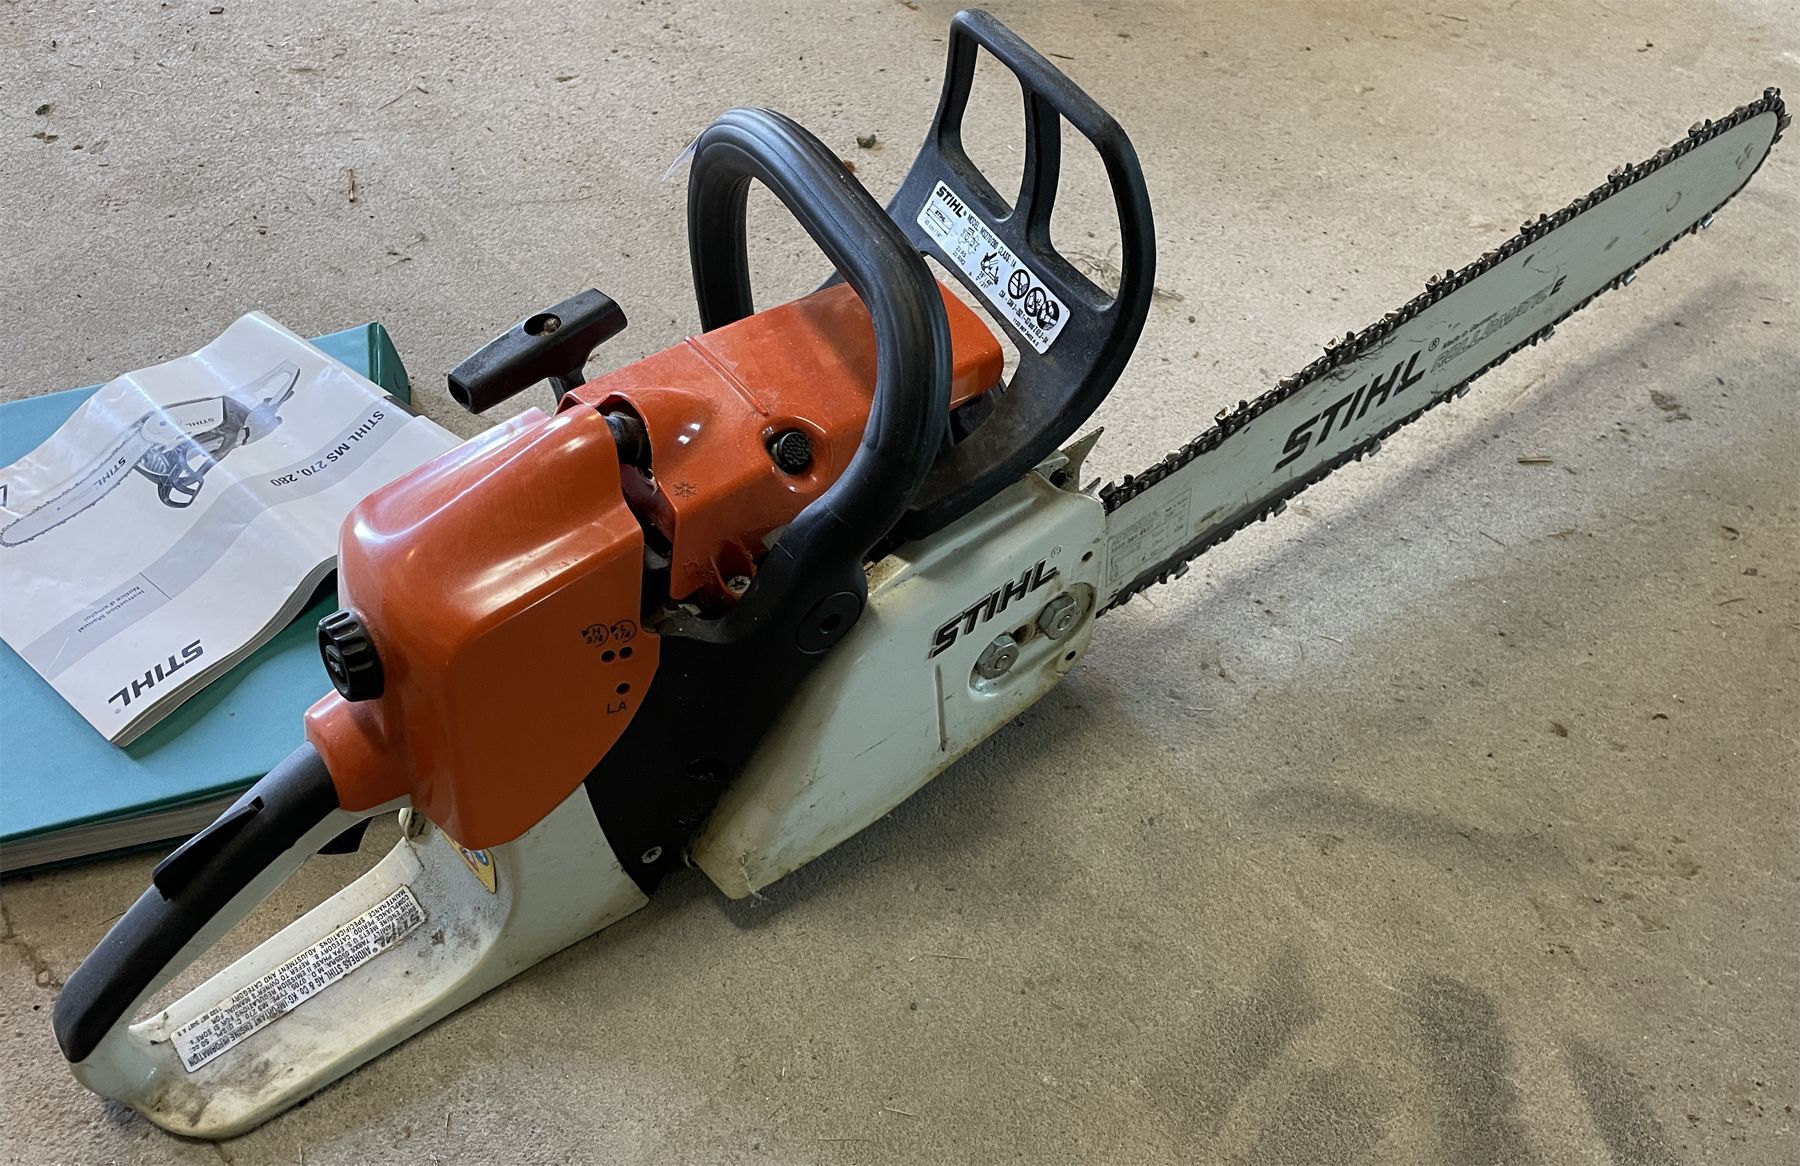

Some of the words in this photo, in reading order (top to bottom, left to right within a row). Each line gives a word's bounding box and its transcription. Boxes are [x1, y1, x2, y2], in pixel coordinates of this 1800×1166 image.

[935, 183, 966, 218] STIHL
[1549, 275, 1567, 297] E
[1272, 351, 1426, 473] STIHL
[348, 411, 384, 441] STIHL
[326, 443, 350, 463] MS
[93, 457, 126, 487] STIHL
[270, 474, 297, 487] 280
[105, 590, 145, 616] Instruction
[115, 585, 140, 604] Notice
[928, 556, 1059, 660] STIHL
[78, 613, 106, 633] Manual
[592, 627, 601, 636] H
[108, 639, 204, 707] STIHL
[607, 701, 628, 714] LA
[373, 894, 410, 921] COMPLIANCE
[398, 899, 413, 912] THIS
[378, 910, 400, 926] ENGINE
[357, 923, 378, 940] MEETS
[319, 933, 351, 956] CATEGORY
[332, 945, 345, 956] EPA
[276, 946, 317, 975] ADJUSTMENT
[289, 959, 310, 975] REFER
[312, 953, 332, 969] PHASE
[341, 945, 372, 970] ANDREAS
[262, 971, 277, 983] AND
[276, 969, 306, 991] EMISSION
[279, 972, 289, 981] TO
[313, 974, 326, 987] AG
[323, 963, 344, 981] STIHL
[250, 977, 280, 999] OWNER'S
[296, 984, 310, 998] Co.
[307, 980, 316, 990] &
[224, 995, 251, 1016] MANUAL
[233, 987, 276, 1018] REGULATIONS
[210, 1012, 224, 1025] FOR
[220, 1014, 234, 1027] FOR
[187, 1034, 230, 1067] INFORMATION
